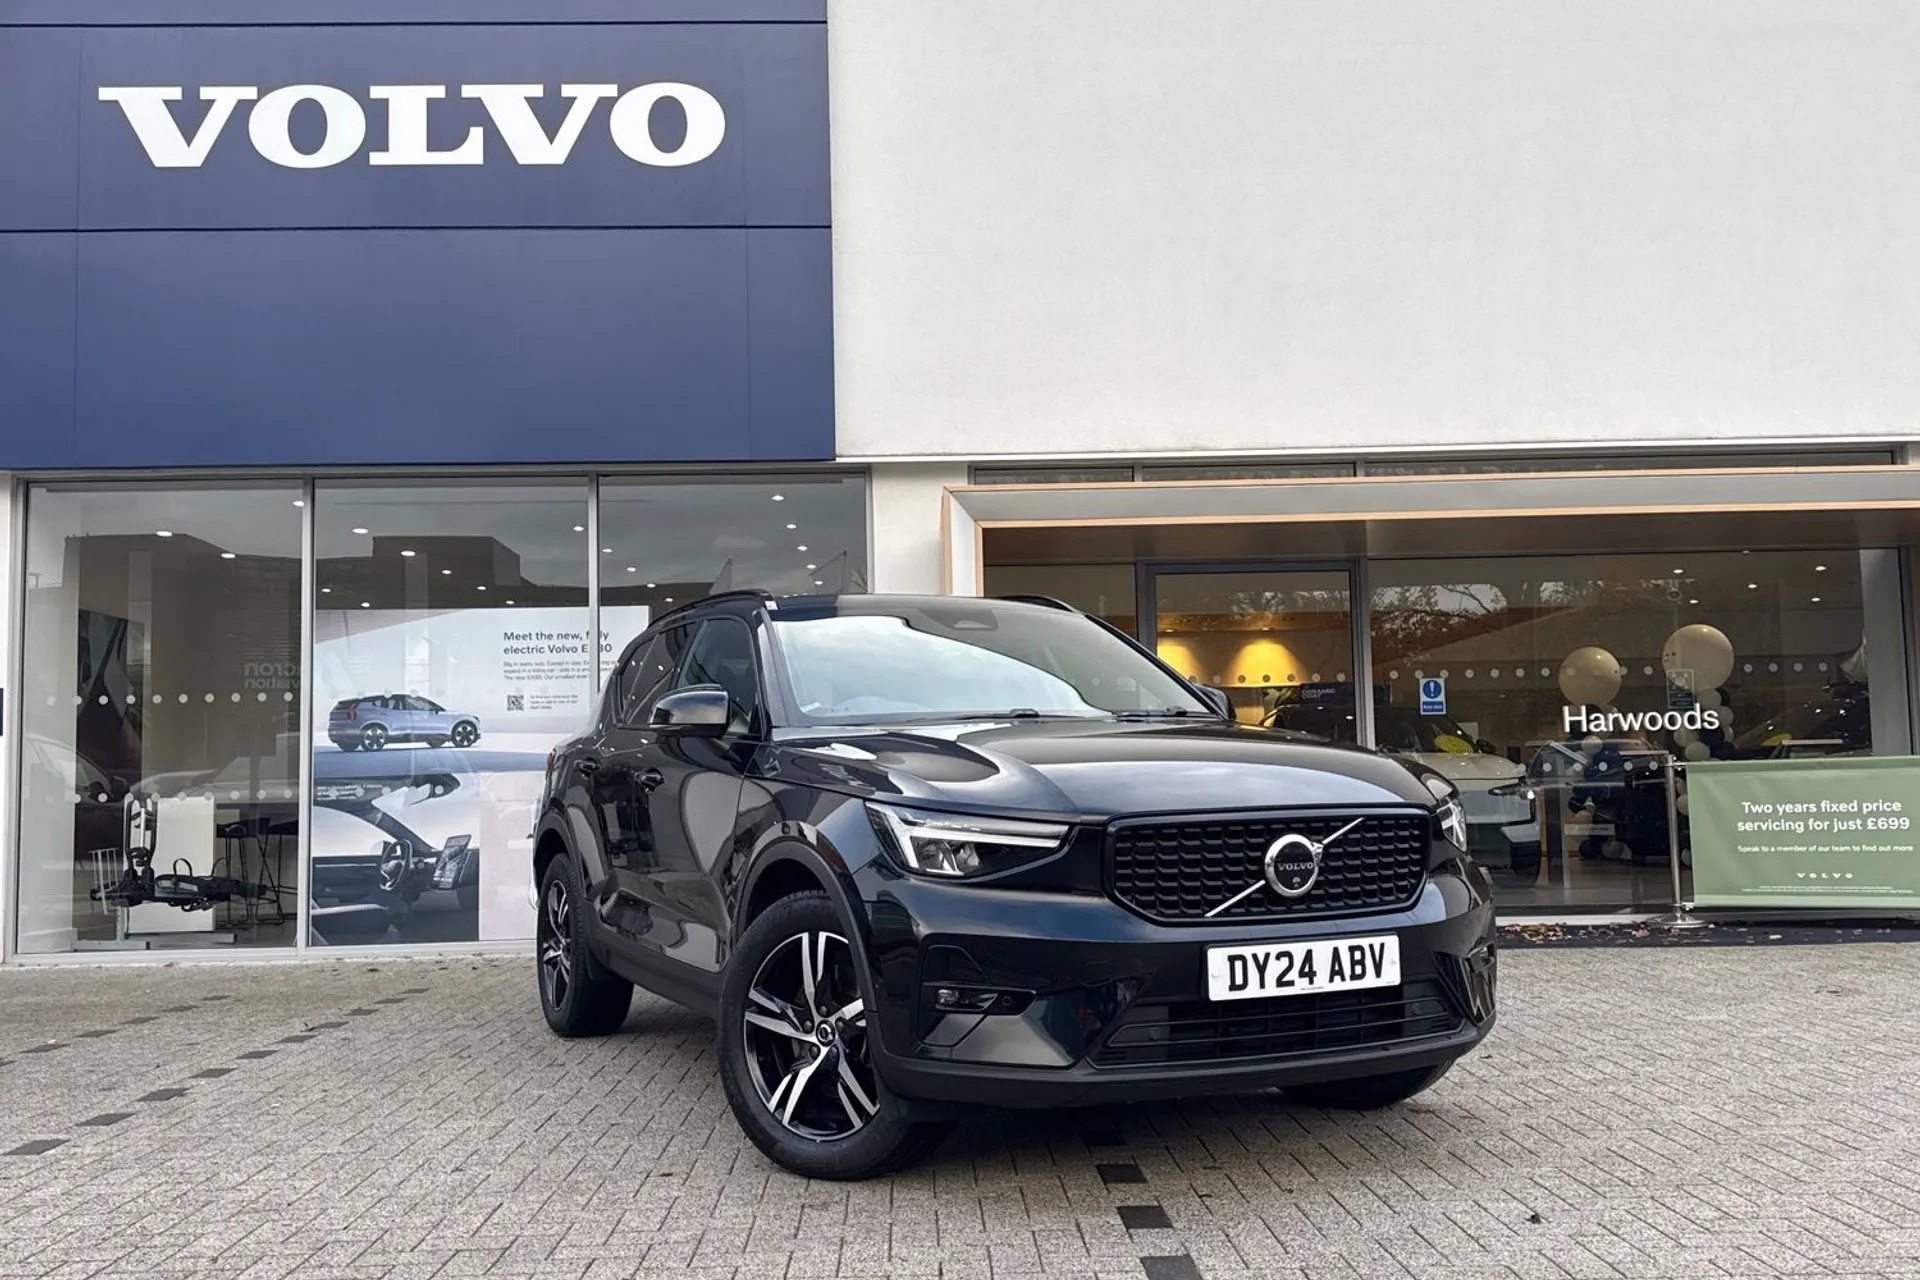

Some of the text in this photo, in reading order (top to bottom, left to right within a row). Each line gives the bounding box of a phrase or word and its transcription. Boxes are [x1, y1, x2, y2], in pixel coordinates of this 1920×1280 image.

[98, 82, 726, 169] VOLVO
[503, 630, 609, 642] Meet the new, fly
[503, 644, 545, 654] electric
[547, 644, 578, 653] Volvo
[1562, 702, 1720, 733] Harwoods
[1741, 799, 1902, 816] Two years fixed price
[1737, 816, 1910, 833] servicing for just £699
[1808, 844, 1816, 852] of
[1277, 862, 1314, 871] VOLVO
[1227, 942, 1385, 992] DY24 ABV
